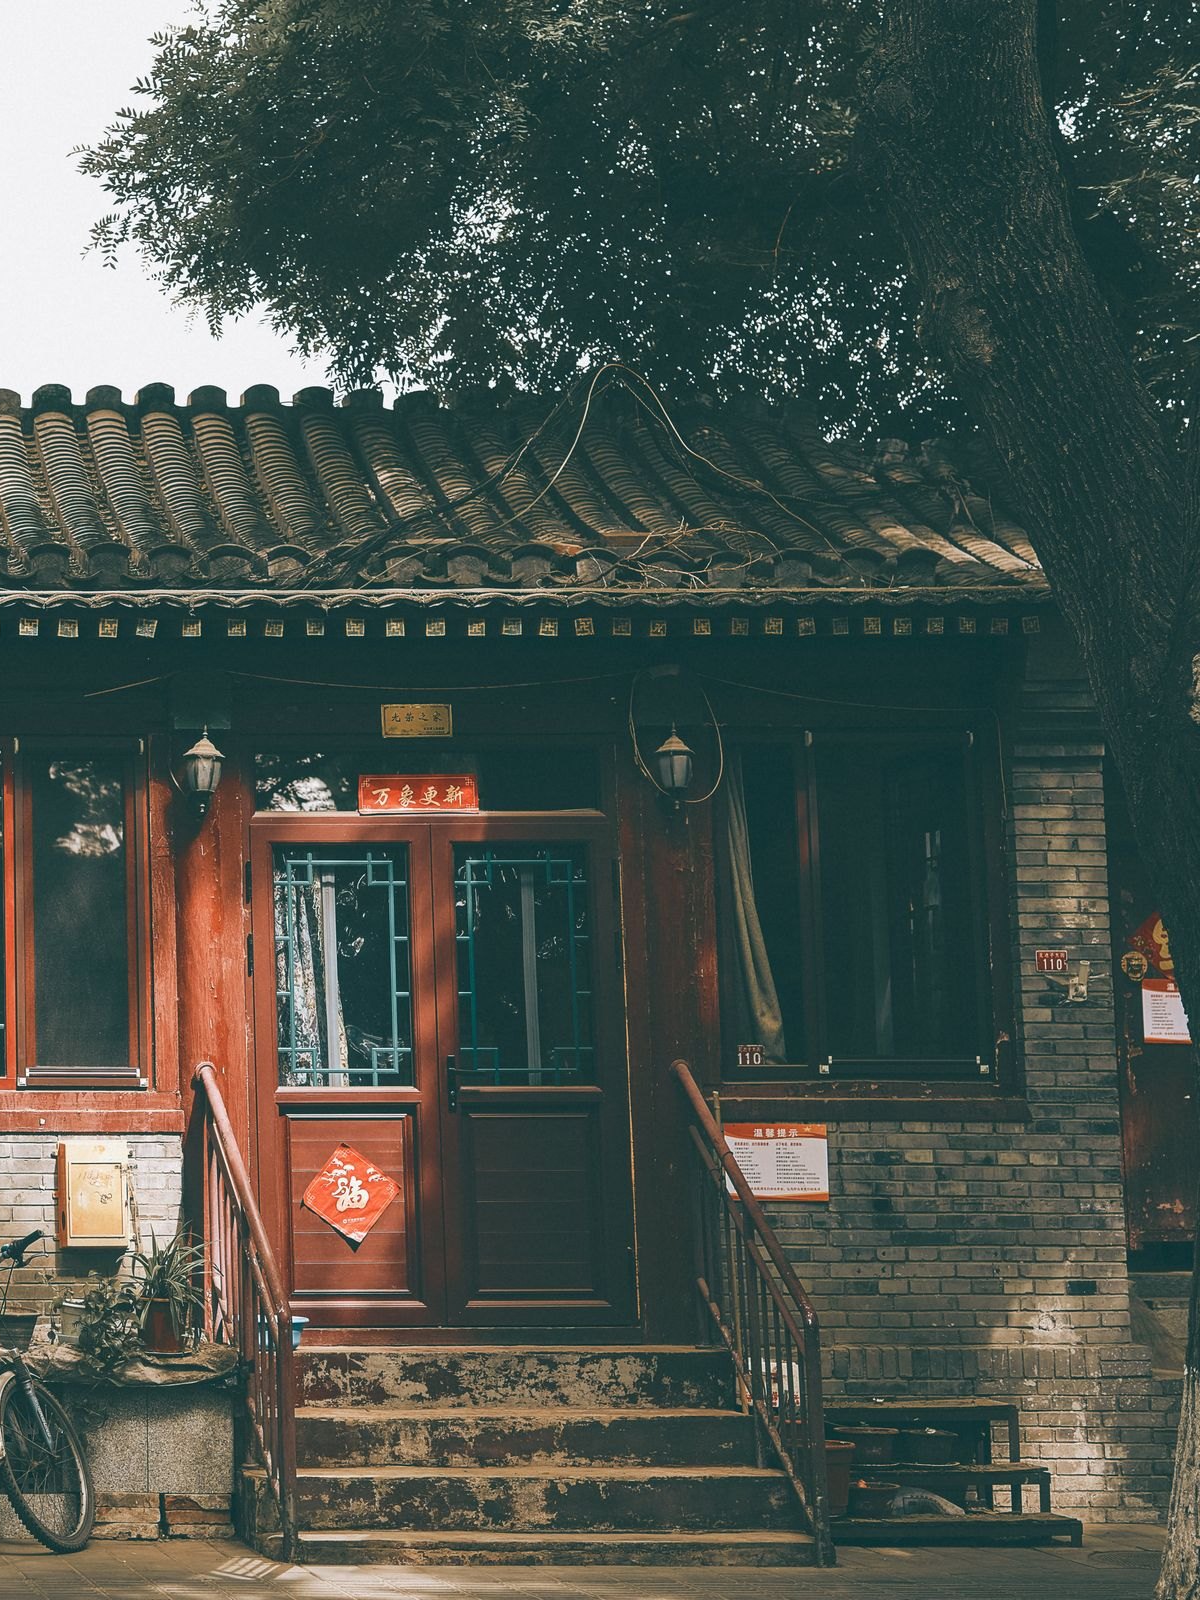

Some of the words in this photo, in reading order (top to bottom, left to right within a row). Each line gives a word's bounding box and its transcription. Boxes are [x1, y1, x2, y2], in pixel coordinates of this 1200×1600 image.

[391, 711, 442, 723] 光荣之家
[371, 784, 464, 807] 万象更新
[1043, 958, 1063, 970] 110
[737, 1052, 761, 1065] 110
[753, 1128, 799, 1138] 温馨提示
